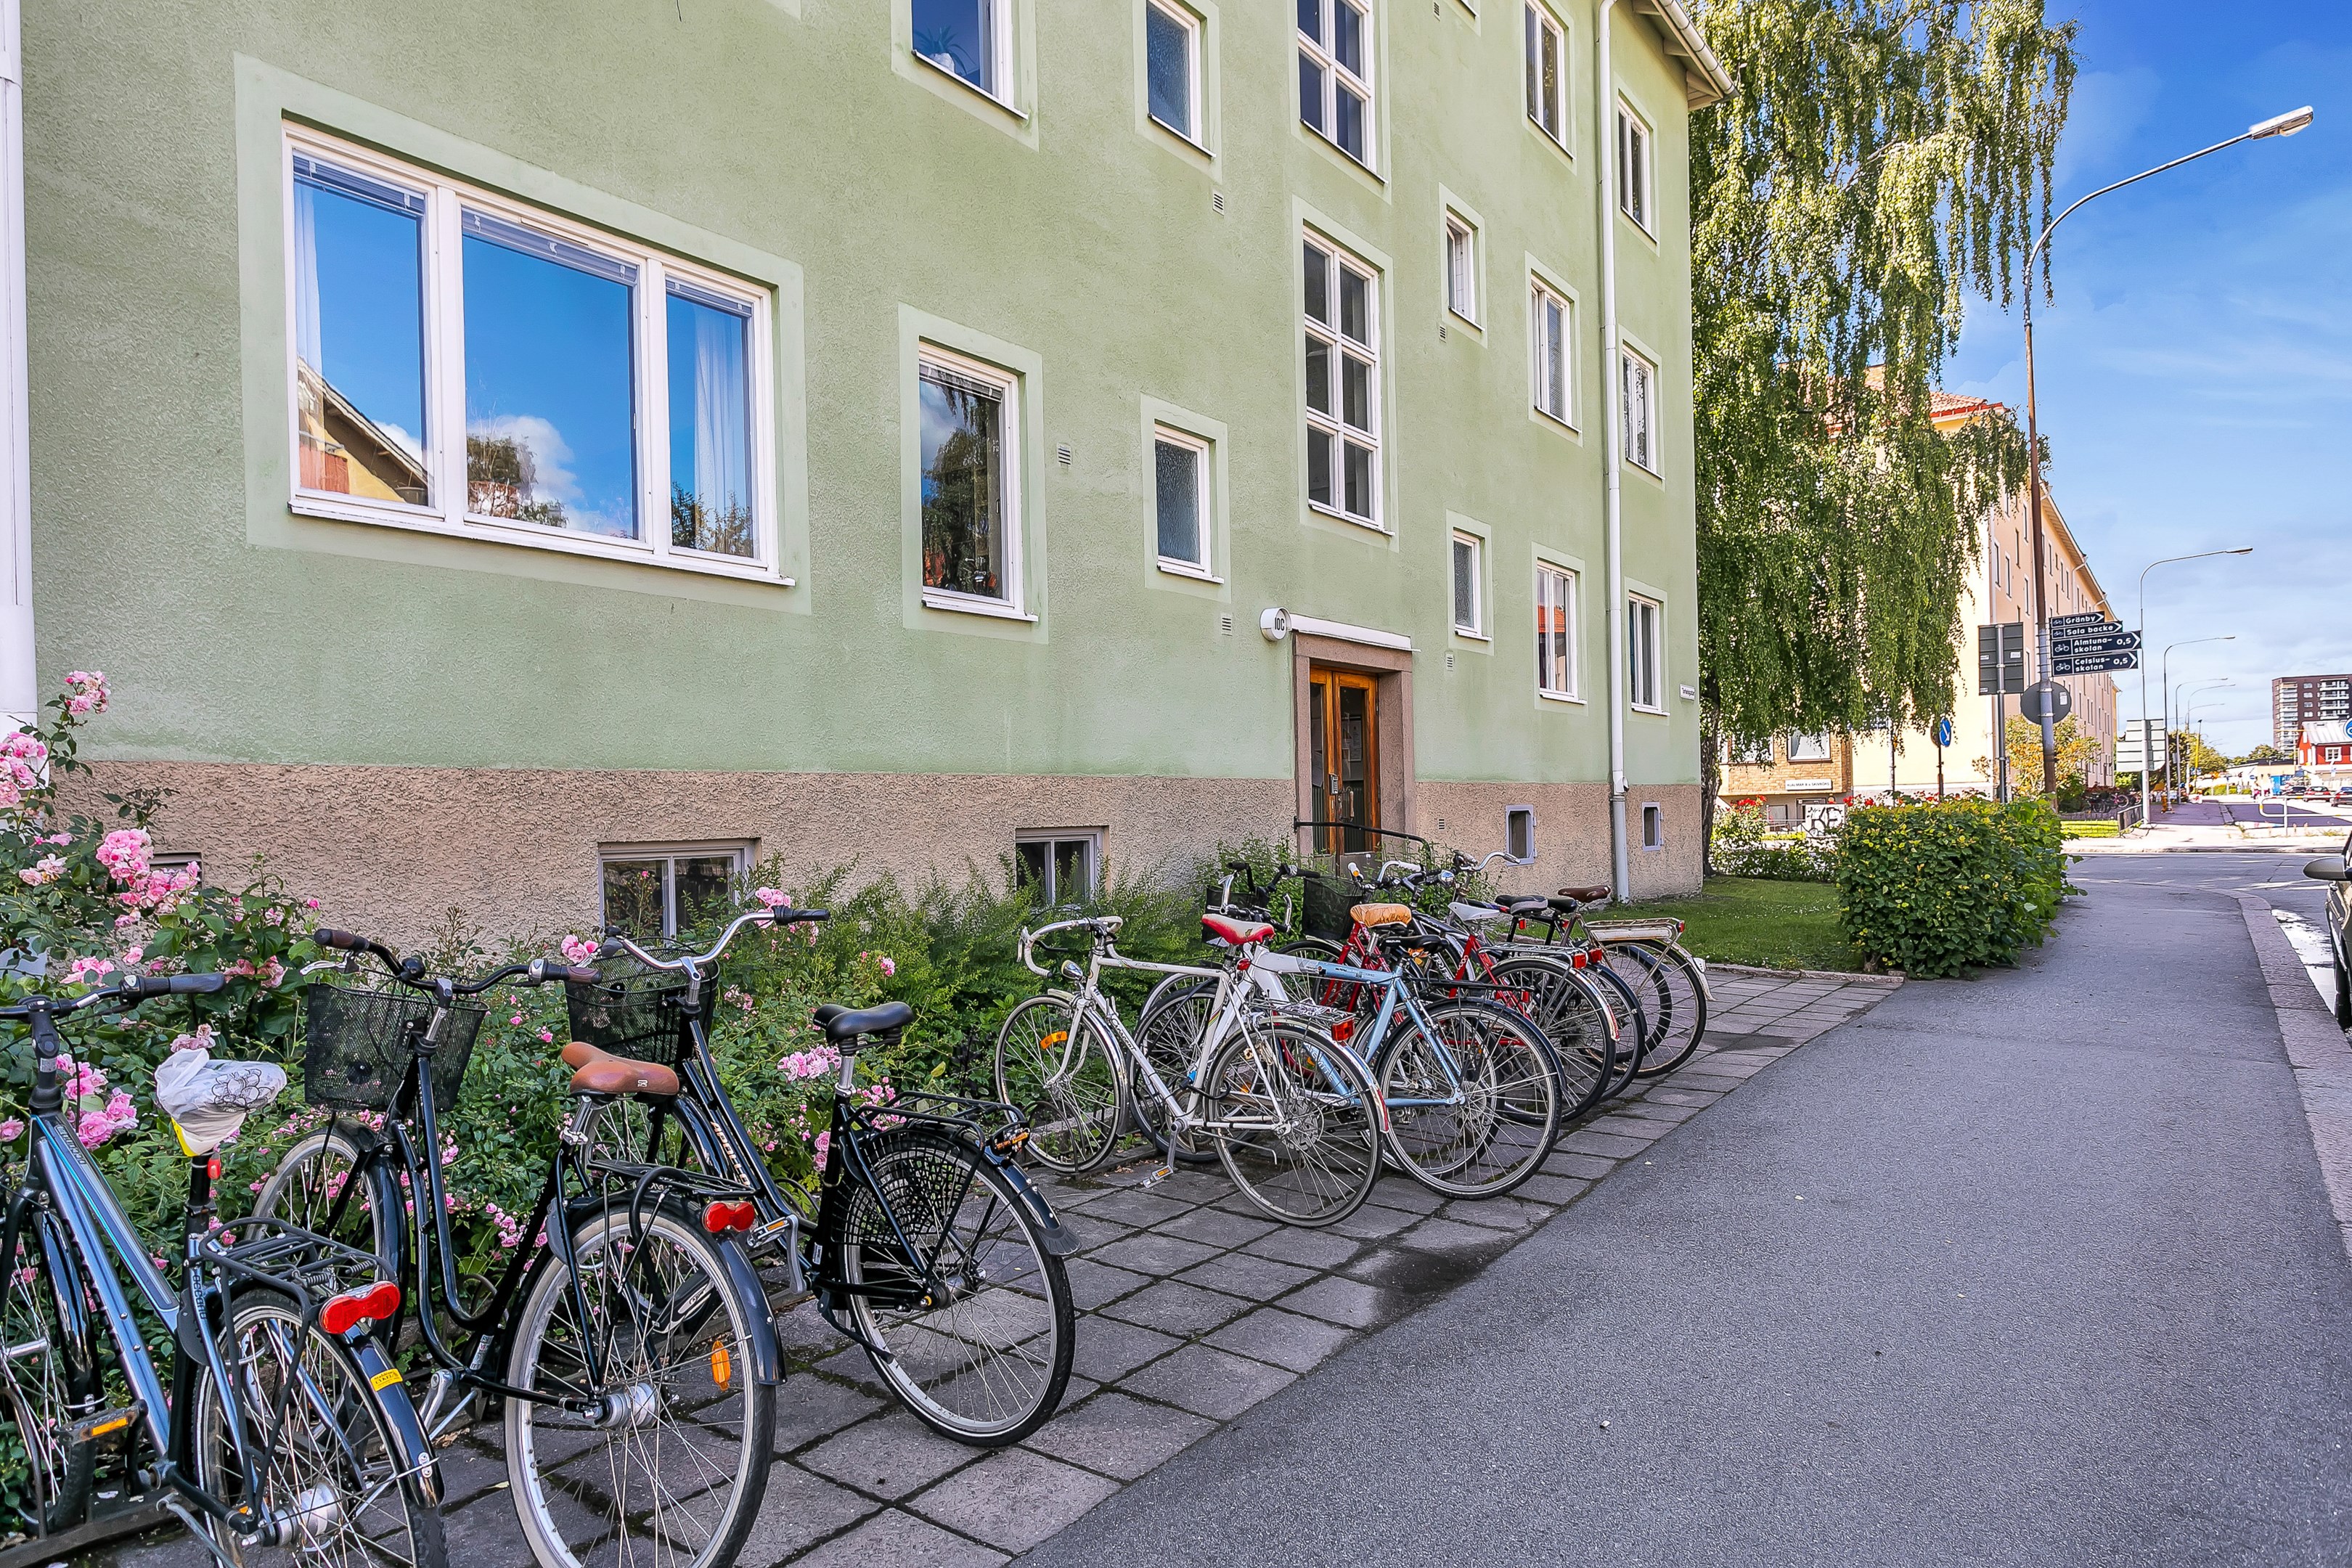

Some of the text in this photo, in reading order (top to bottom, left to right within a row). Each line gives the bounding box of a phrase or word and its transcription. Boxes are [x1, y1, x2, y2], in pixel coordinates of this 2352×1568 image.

[2065, 616, 2096, 624] Gränby
[2067, 625, 2114, 636] Sala backe
[2074, 645, 2102, 653] skolan
[2113, 657, 2128, 666] 0,5
[1110, 1018, 1137, 1052] Crescent
[710, 1121, 751, 1186] APOLLO
